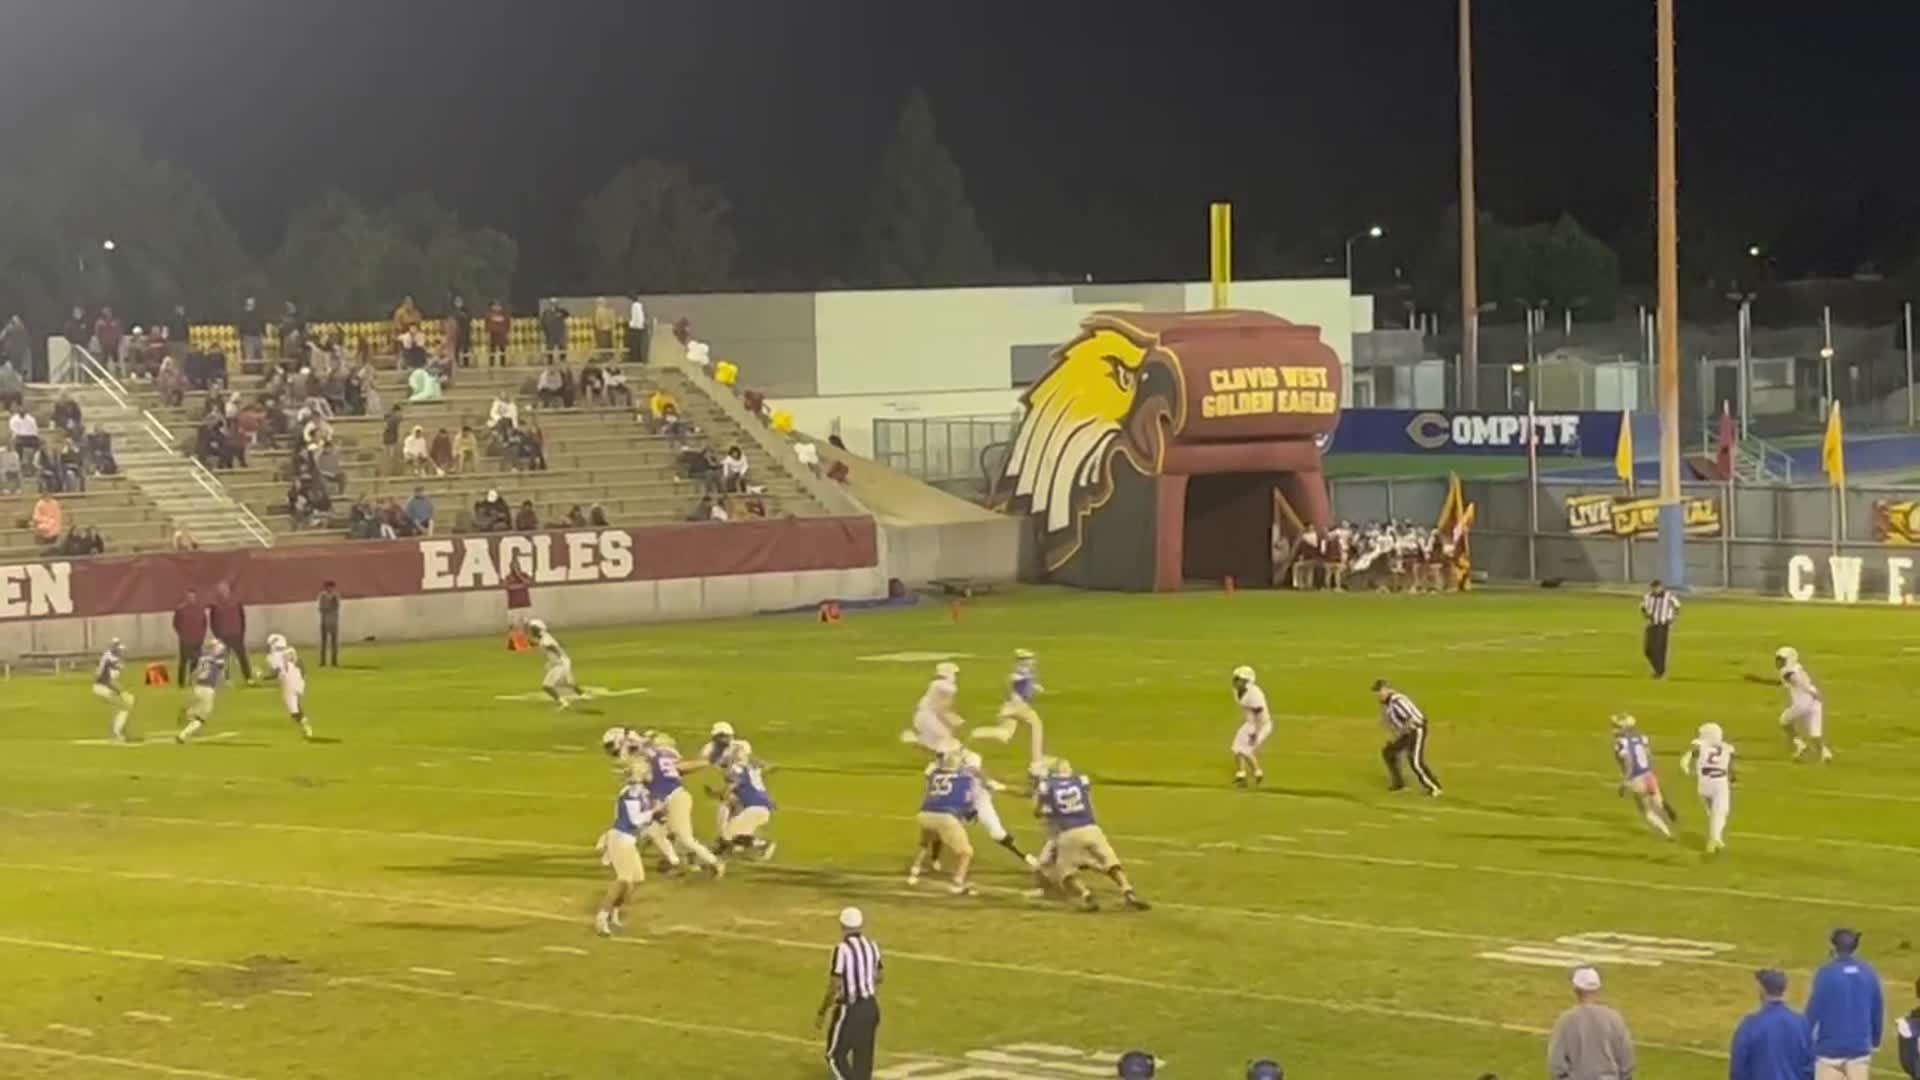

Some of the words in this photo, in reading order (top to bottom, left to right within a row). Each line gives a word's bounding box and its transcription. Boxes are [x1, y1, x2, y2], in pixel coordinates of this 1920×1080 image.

[1210, 367, 1278, 392] CLOVIS
[1280, 366, 1327, 388] WEST
[1202, 391, 1274, 418] GOLDEN
[1277, 390, 1336, 414] EAGLES
[1569, 501, 1612, 527] LIVE
[419, 530, 633, 589] EAGLES
[1788, 555, 1815, 601] C
[1706, 744, 1723, 764] 2
[1055, 785, 1085, 814] 52
